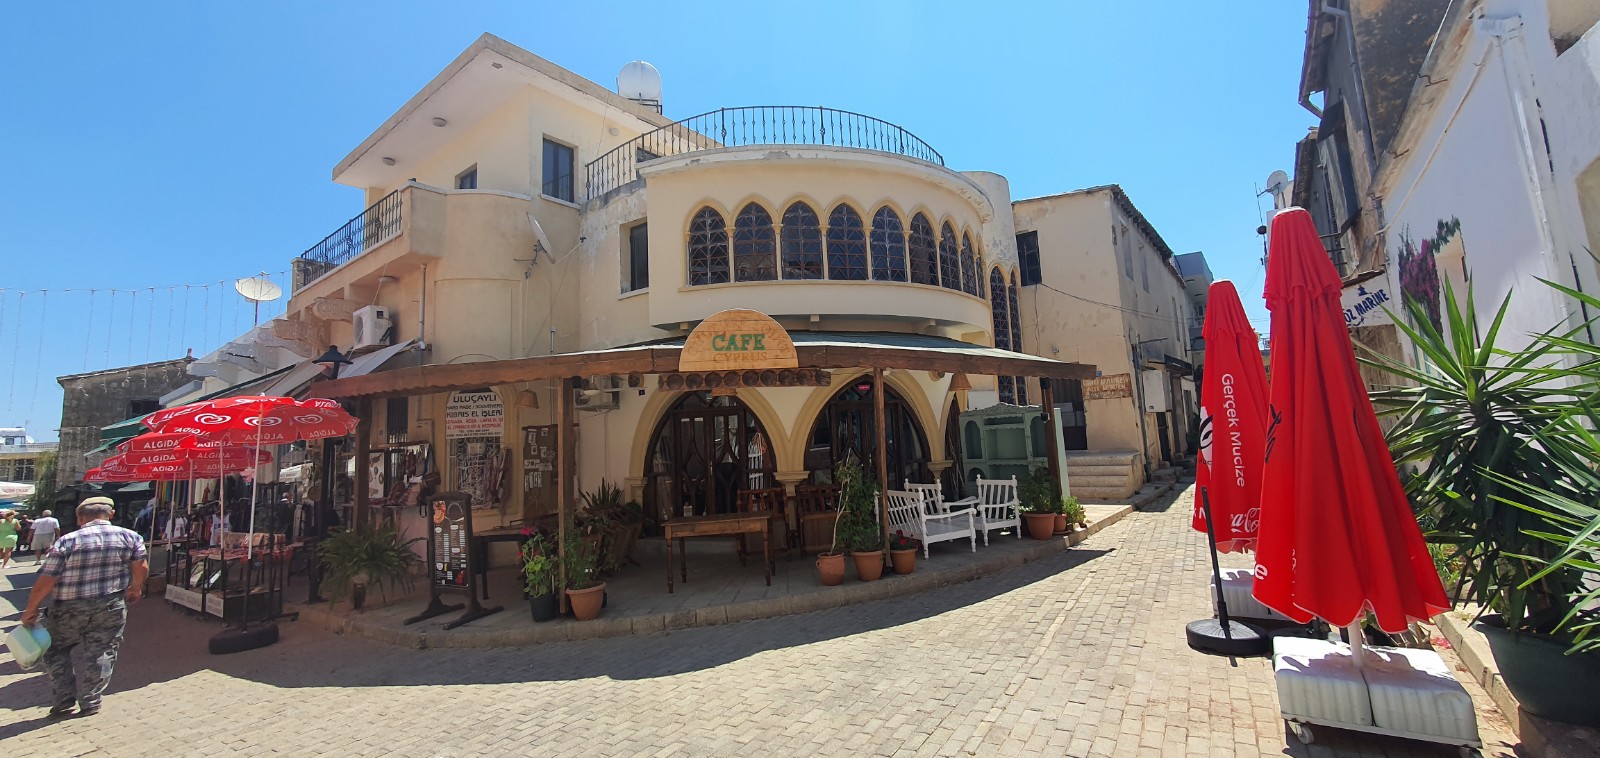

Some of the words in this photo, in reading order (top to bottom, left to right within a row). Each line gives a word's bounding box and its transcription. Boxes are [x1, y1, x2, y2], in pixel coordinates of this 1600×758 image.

[712, 333, 766, 351] CAFE
[713, 352, 768, 363] CYPRUS
[453, 395, 496, 403] ULUÇAYLI
[1221, 373, 1238, 428] Gerçek
[481, 408, 503, 417] İŞLERİ
[143, 439, 179, 449] ALGIDA
[140, 454, 177, 463] ALGIDA
[1229, 431, 1245, 487] Mucize
